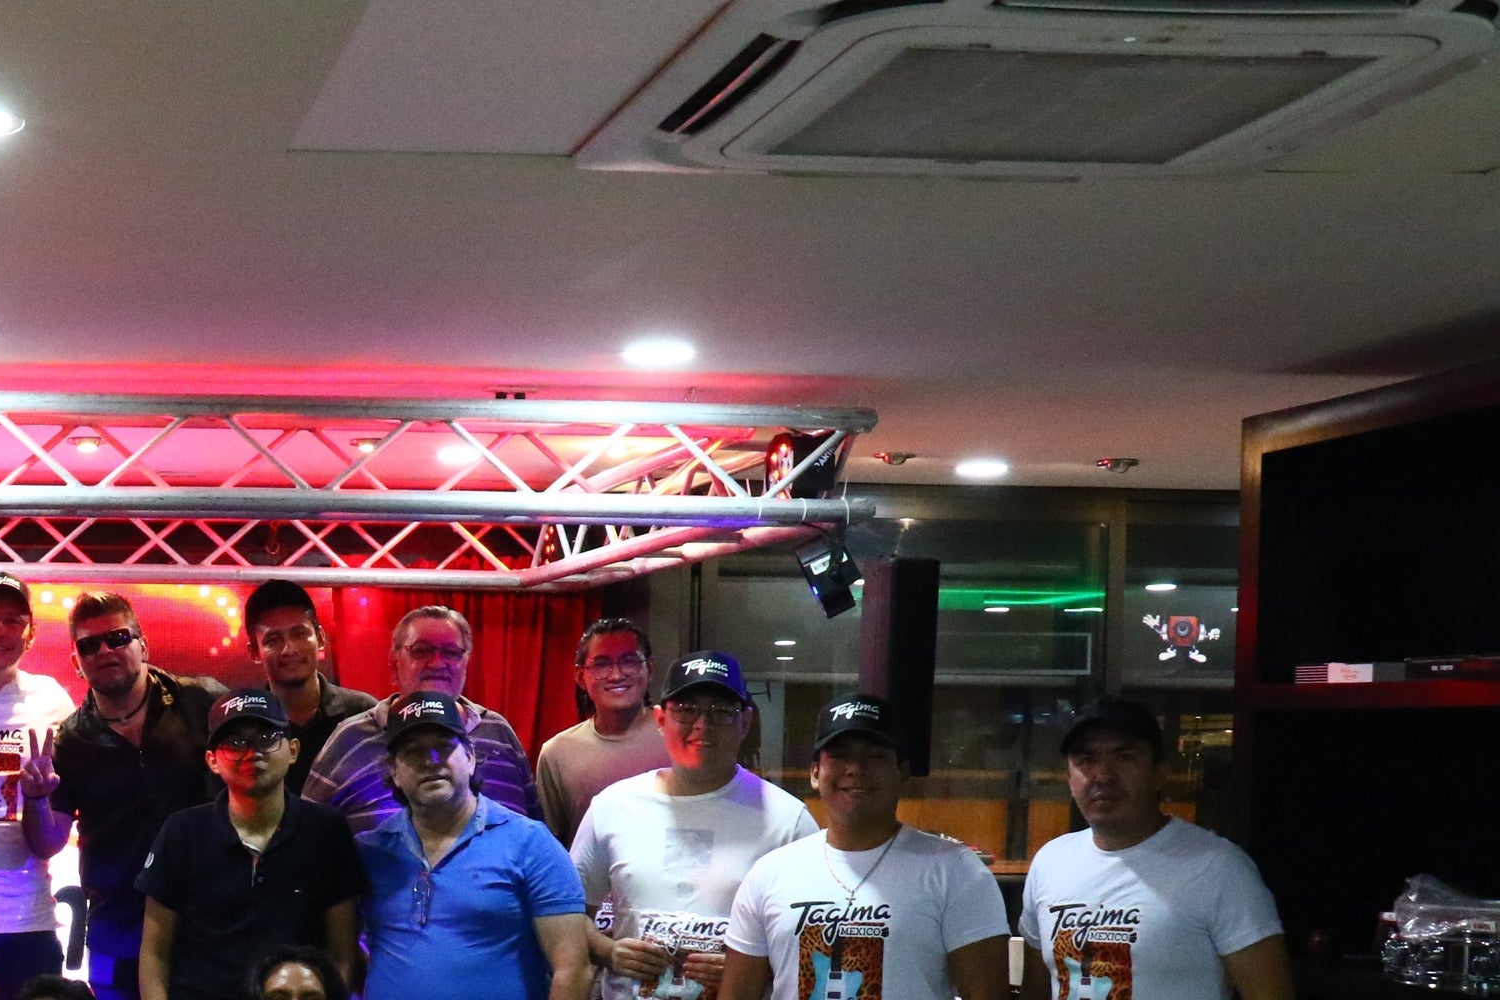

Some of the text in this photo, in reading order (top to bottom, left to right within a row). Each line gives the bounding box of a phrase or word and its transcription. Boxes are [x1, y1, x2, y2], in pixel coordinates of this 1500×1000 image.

[681, 658, 729, 676] Tagima
[220, 694, 268, 715] Tagima
[398, 699, 445, 721] Tagima
[829, 701, 880, 721] Tagima
[789, 901, 892, 944] Tagima
[840, 927, 881, 937] MEXICO
[1049, 903, 1141, 950] Tagima
[1089, 932, 1129, 941] MEXICO
